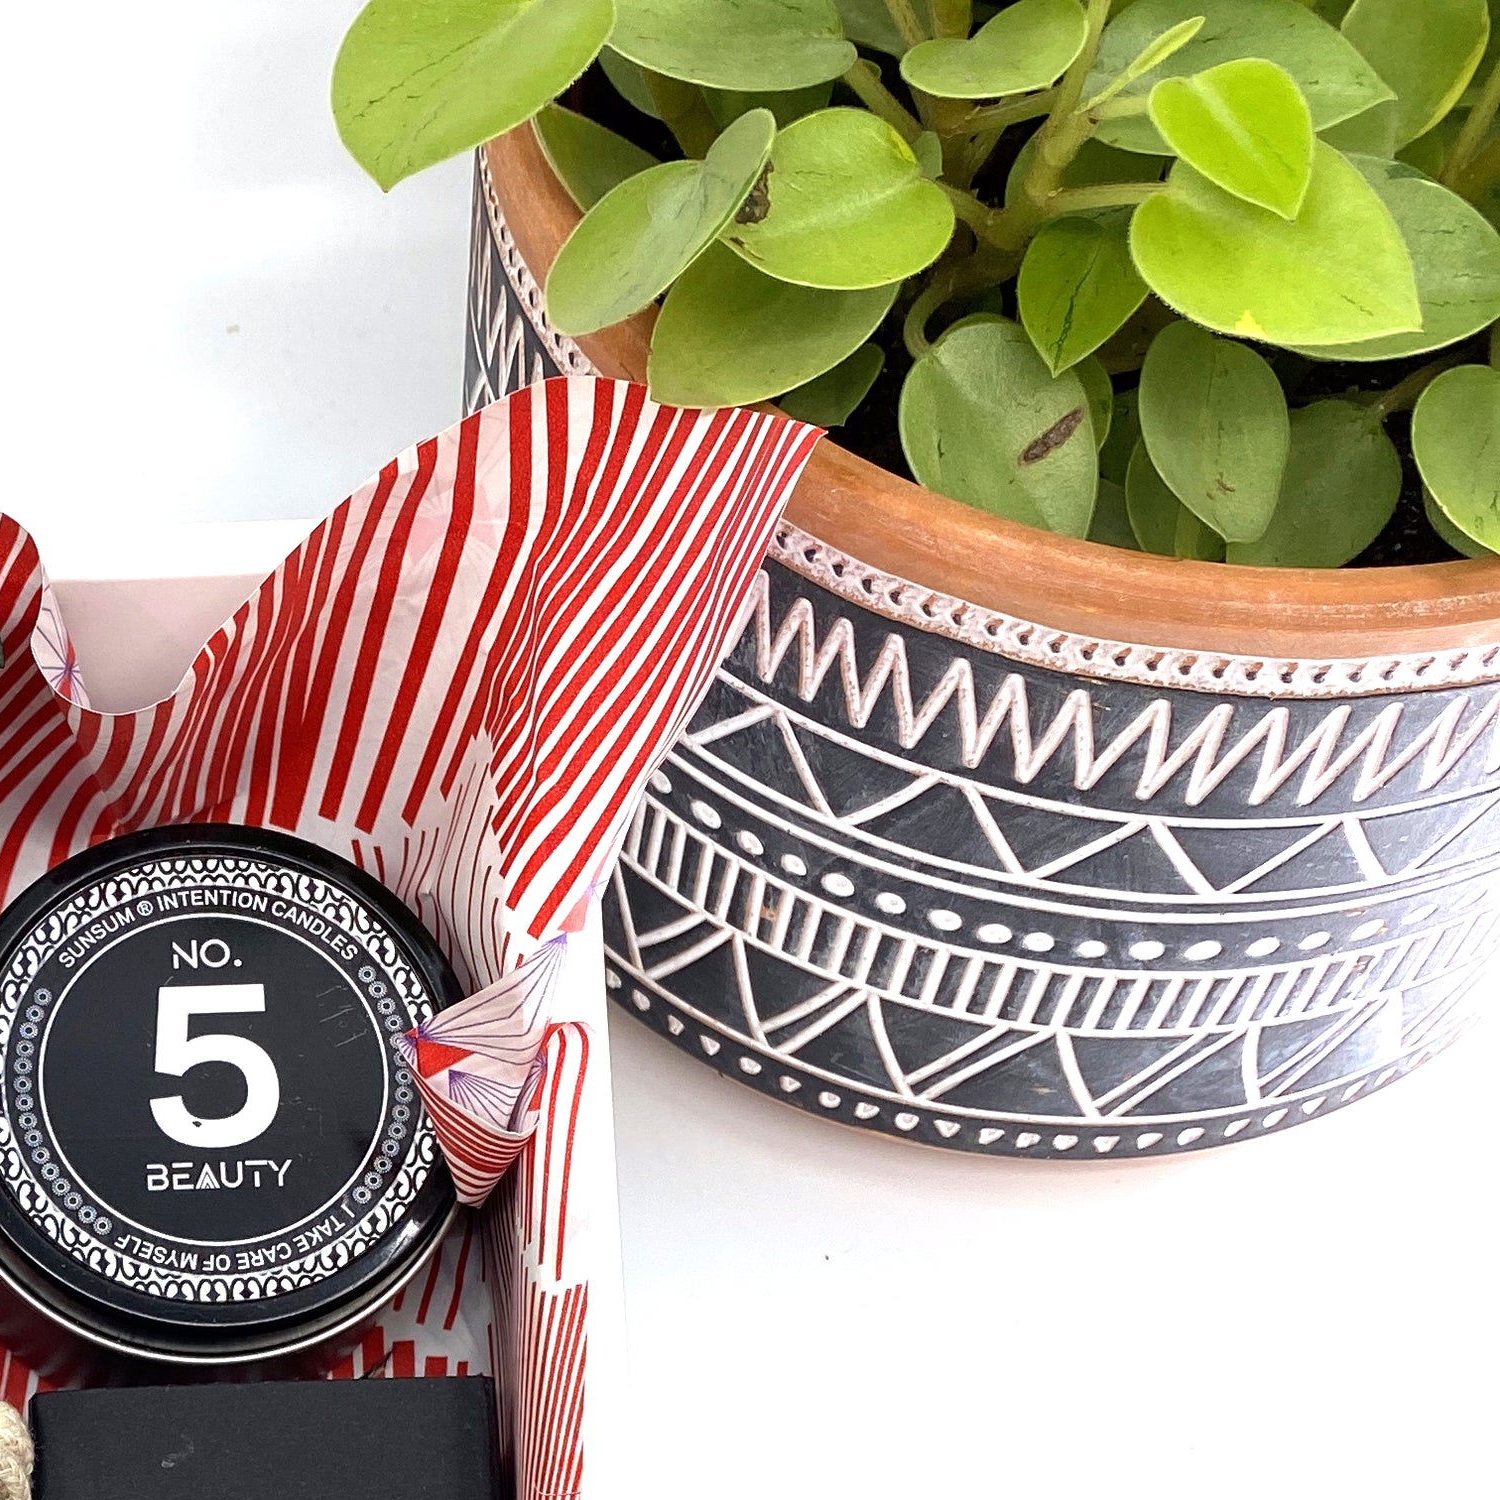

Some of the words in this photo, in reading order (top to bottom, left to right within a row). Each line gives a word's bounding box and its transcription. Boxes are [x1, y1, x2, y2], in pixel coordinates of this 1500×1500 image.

[58, 906, 136, 969] SUNSUM
[156, 888, 268, 913] INTENTION
[270, 900, 359, 962] CANDLES
[171, 938, 243, 970] NO.
[148, 983, 281, 1149] 5
[145, 1158, 292, 1192] BEAUTY
[291, 1212, 346, 1248] TAKE
[113, 1233, 199, 1271] MYSELF
[202, 1255, 231, 1272] OF
[234, 1242, 293, 1271] CARE
